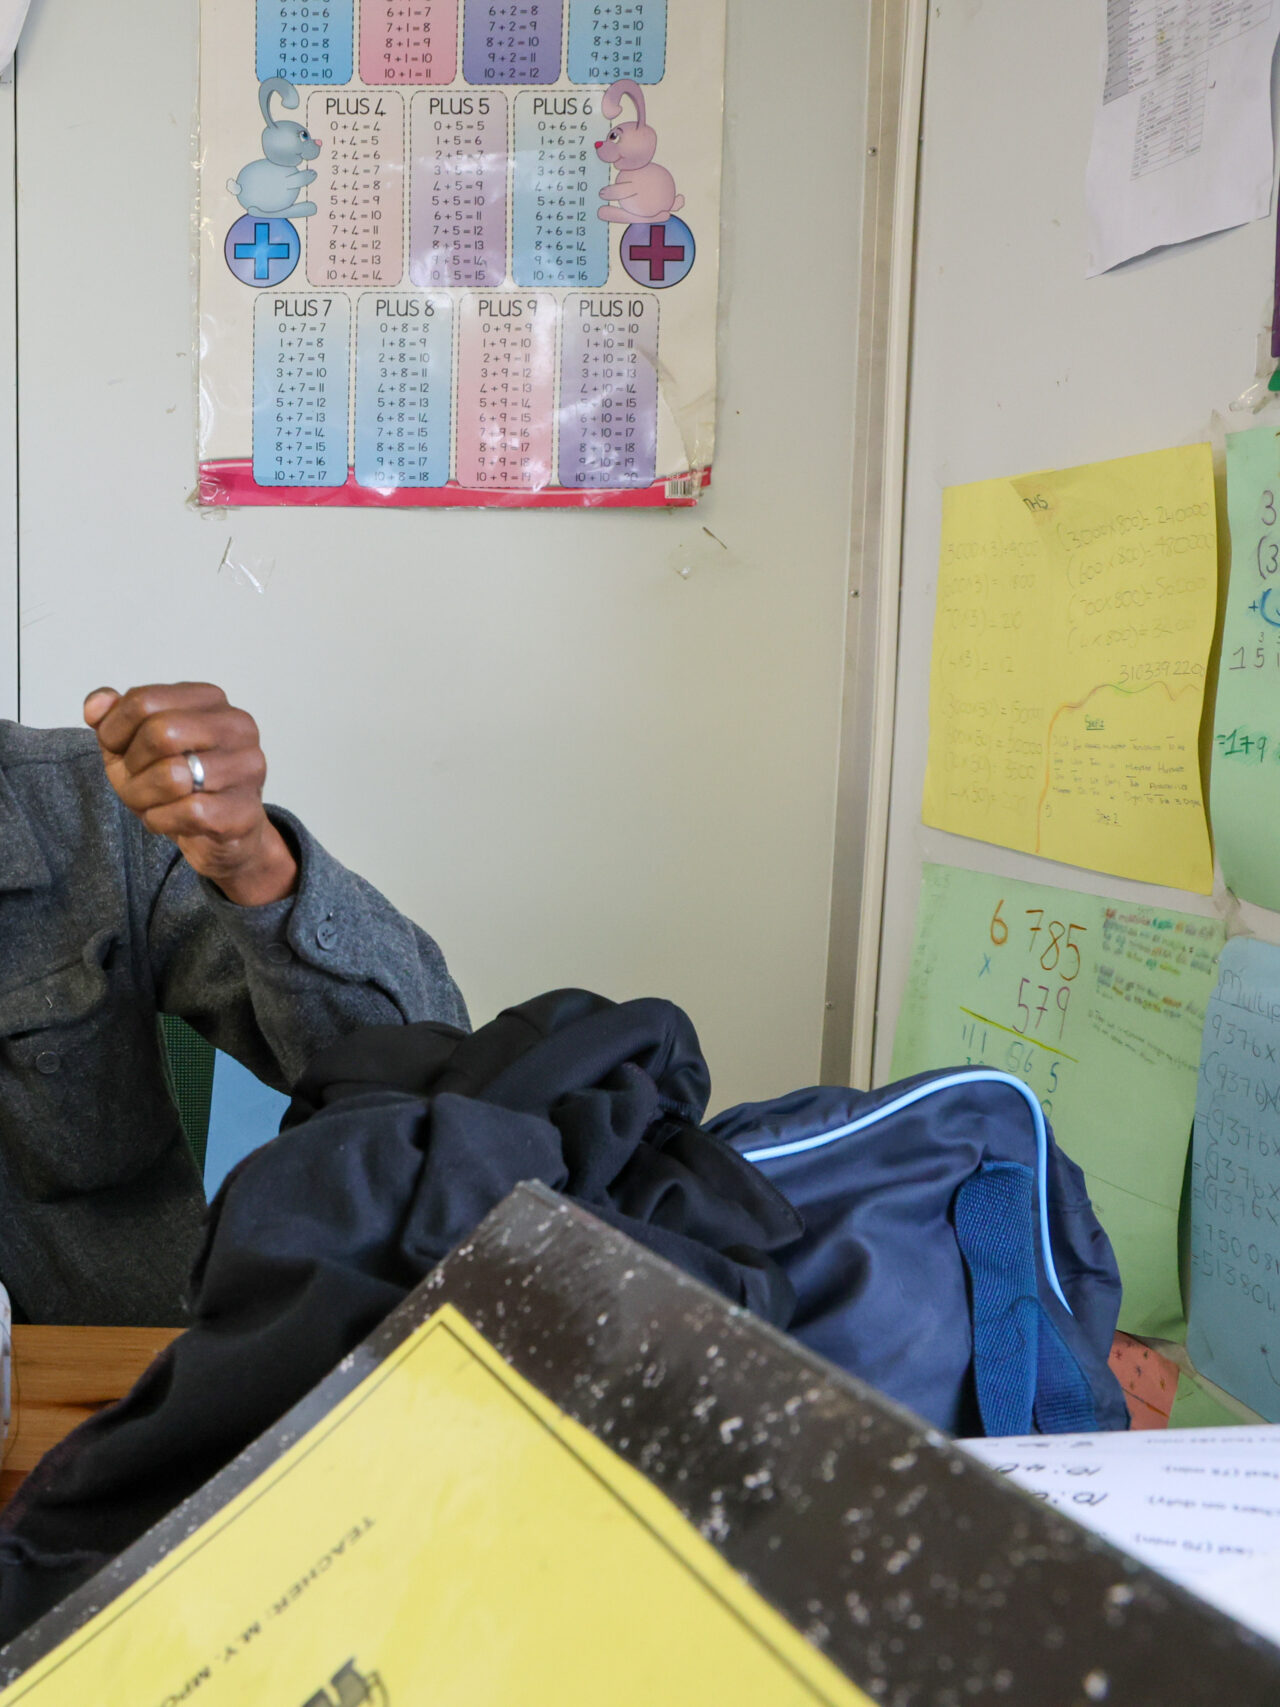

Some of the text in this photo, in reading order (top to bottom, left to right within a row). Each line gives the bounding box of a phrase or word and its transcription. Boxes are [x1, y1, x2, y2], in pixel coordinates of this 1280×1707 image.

[325, 98, 387, 117] PLUS 4
[430, 98, 490, 115] PLUS 5
[533, 98, 593, 115] PLUS 6
[274, 299, 332, 317] PLUS 7
[376, 300, 435, 317] PLUS 8
[478, 299, 537, 317] PLUS 9
[579, 300, 644, 317] PLUS 10
[1218, 967, 1280, 1024] Multip
[1012, 978, 1071, 1041] 579
